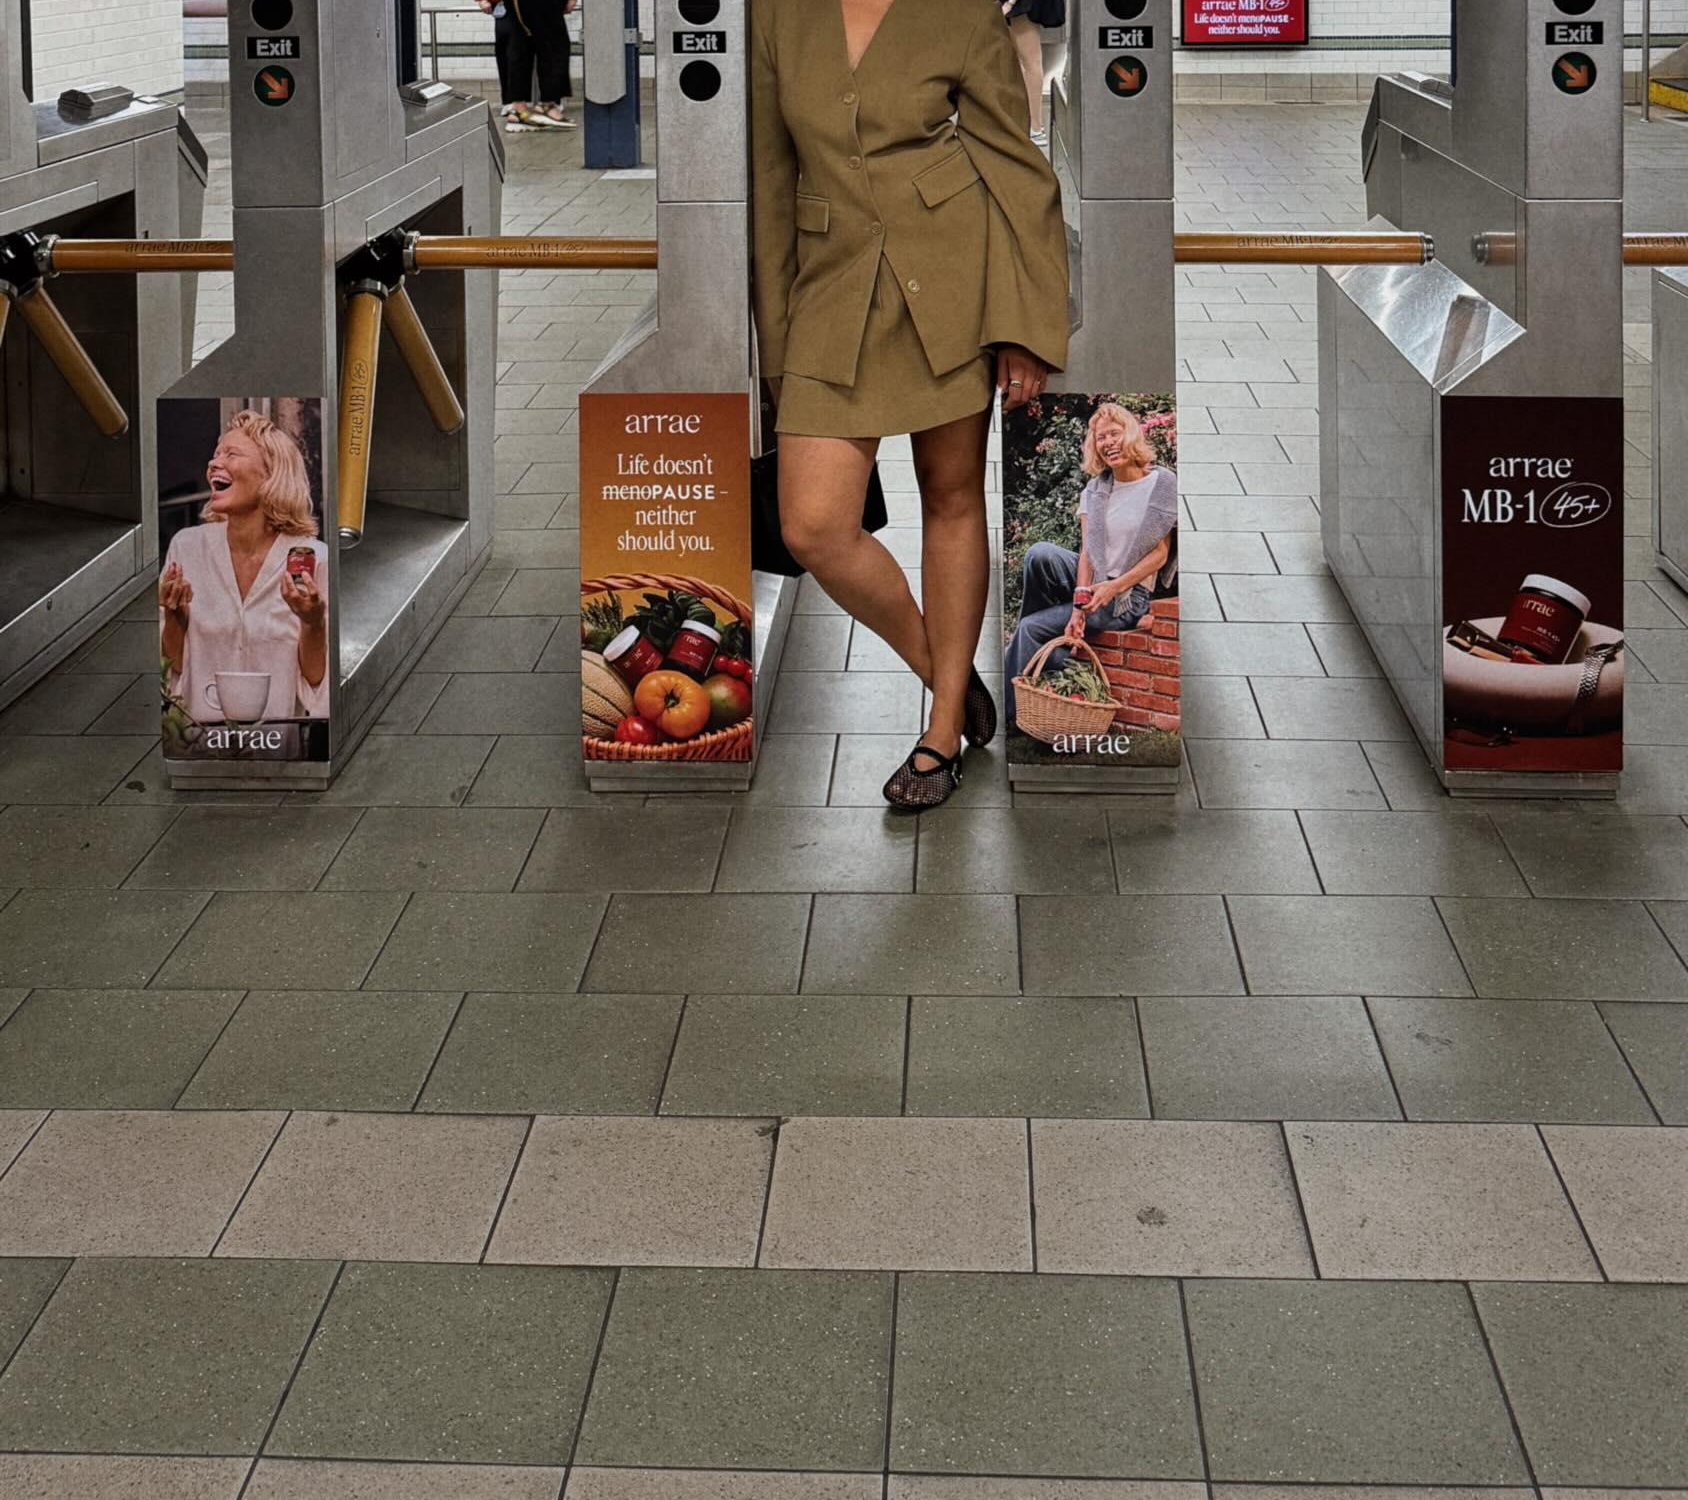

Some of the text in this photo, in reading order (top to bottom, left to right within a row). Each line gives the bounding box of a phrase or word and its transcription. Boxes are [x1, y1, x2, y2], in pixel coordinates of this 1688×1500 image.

[1202, 0, 1236, 11] arrae
[1194, 13, 1209, 24] Life
[1107, 29, 1144, 46] Exit
[1236, 24, 1263, 35] should
[1264, 26, 1280, 37] you.
[1554, 25, 1593, 42] Exit
[256, 39, 293, 56] Exit
[682, 34, 718, 51] Exit
[624, 414, 701, 434] arrae
[349, 417, 364, 456] arrae
[617, 453, 713, 475] Life doesn't
[1489, 457, 1572, 478] arrae
[602, 484, 716, 500] menoPAUSE
[635, 504, 697, 526] neither
[1461, 489, 1600, 523] MB-1 45+
[617, 529, 715, 557] should you.
[207, 729, 282, 749] arrae
[1052, 733, 1131, 755] arrae
